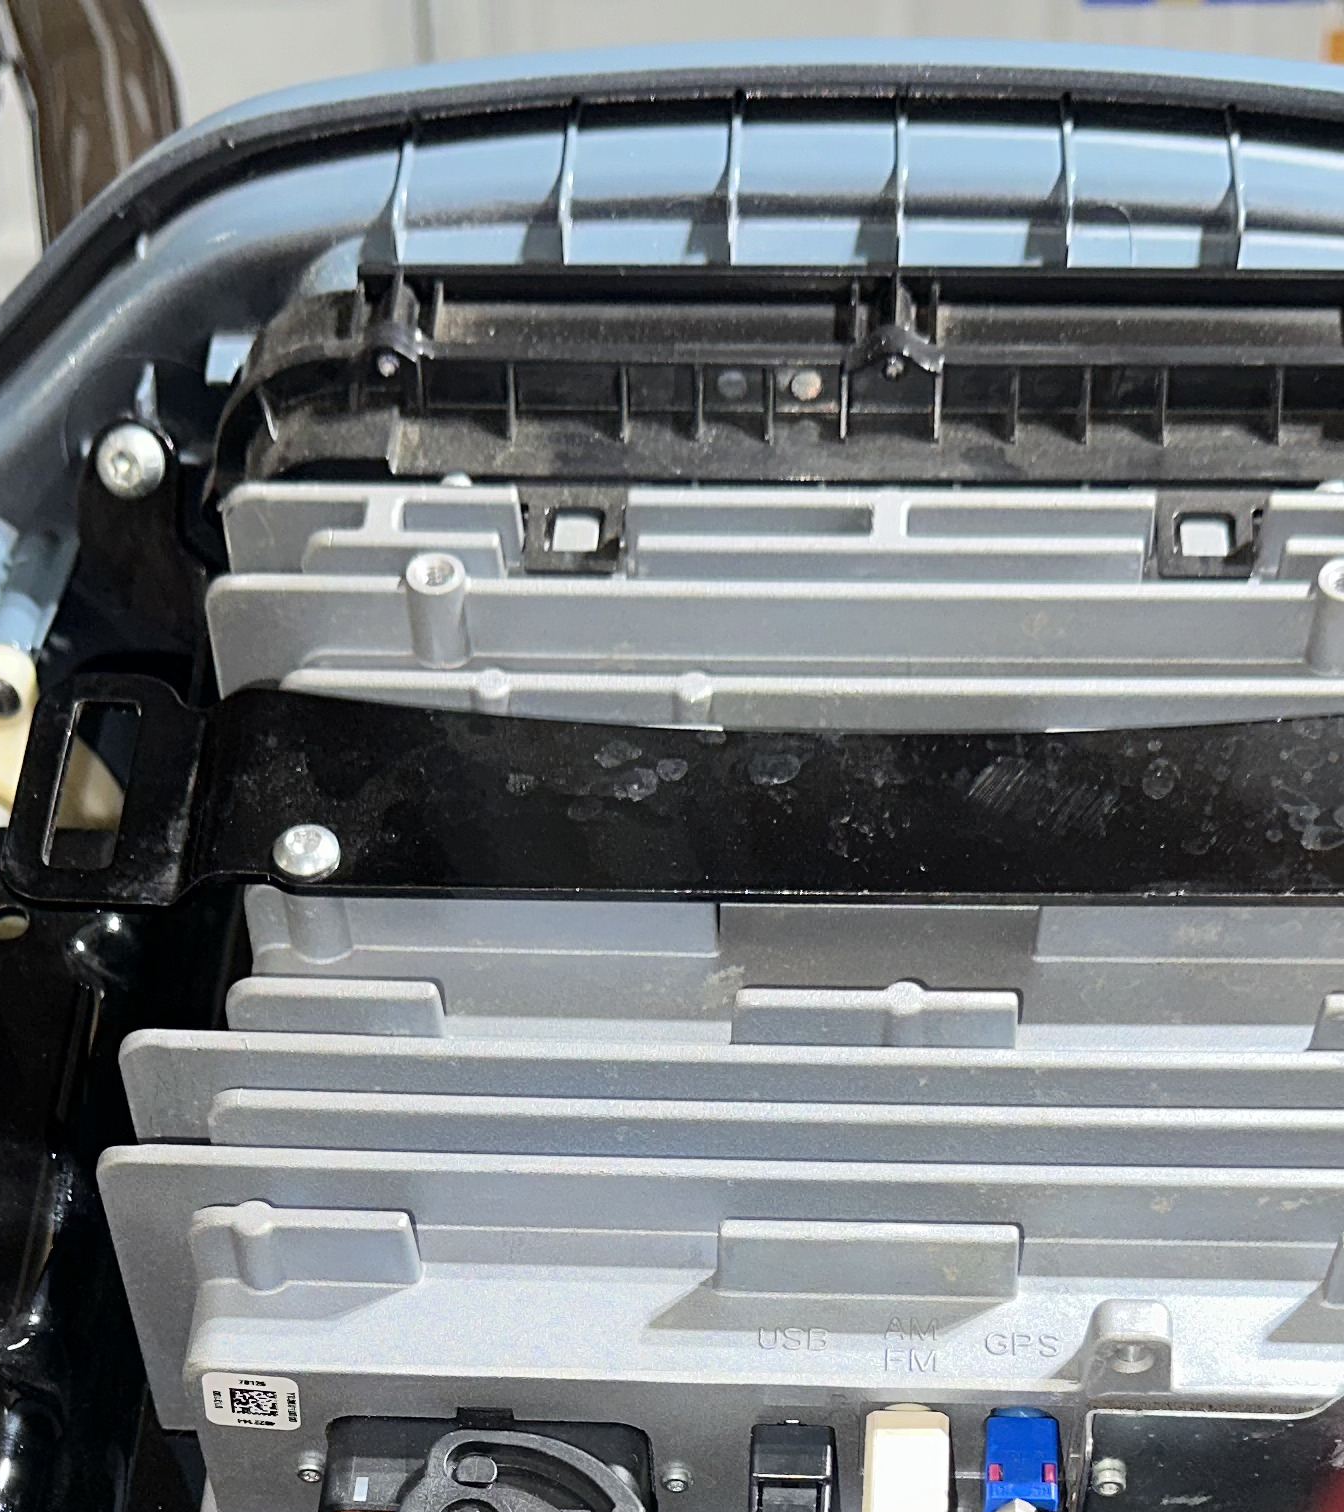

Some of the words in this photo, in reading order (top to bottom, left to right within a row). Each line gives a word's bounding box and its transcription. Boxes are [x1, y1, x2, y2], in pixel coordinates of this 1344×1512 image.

[757, 1326, 830, 1351] USB
[883, 1316, 940, 1341] AM
[984, 1332, 1061, 1358] GPS
[883, 1347, 940, 1373] FM
